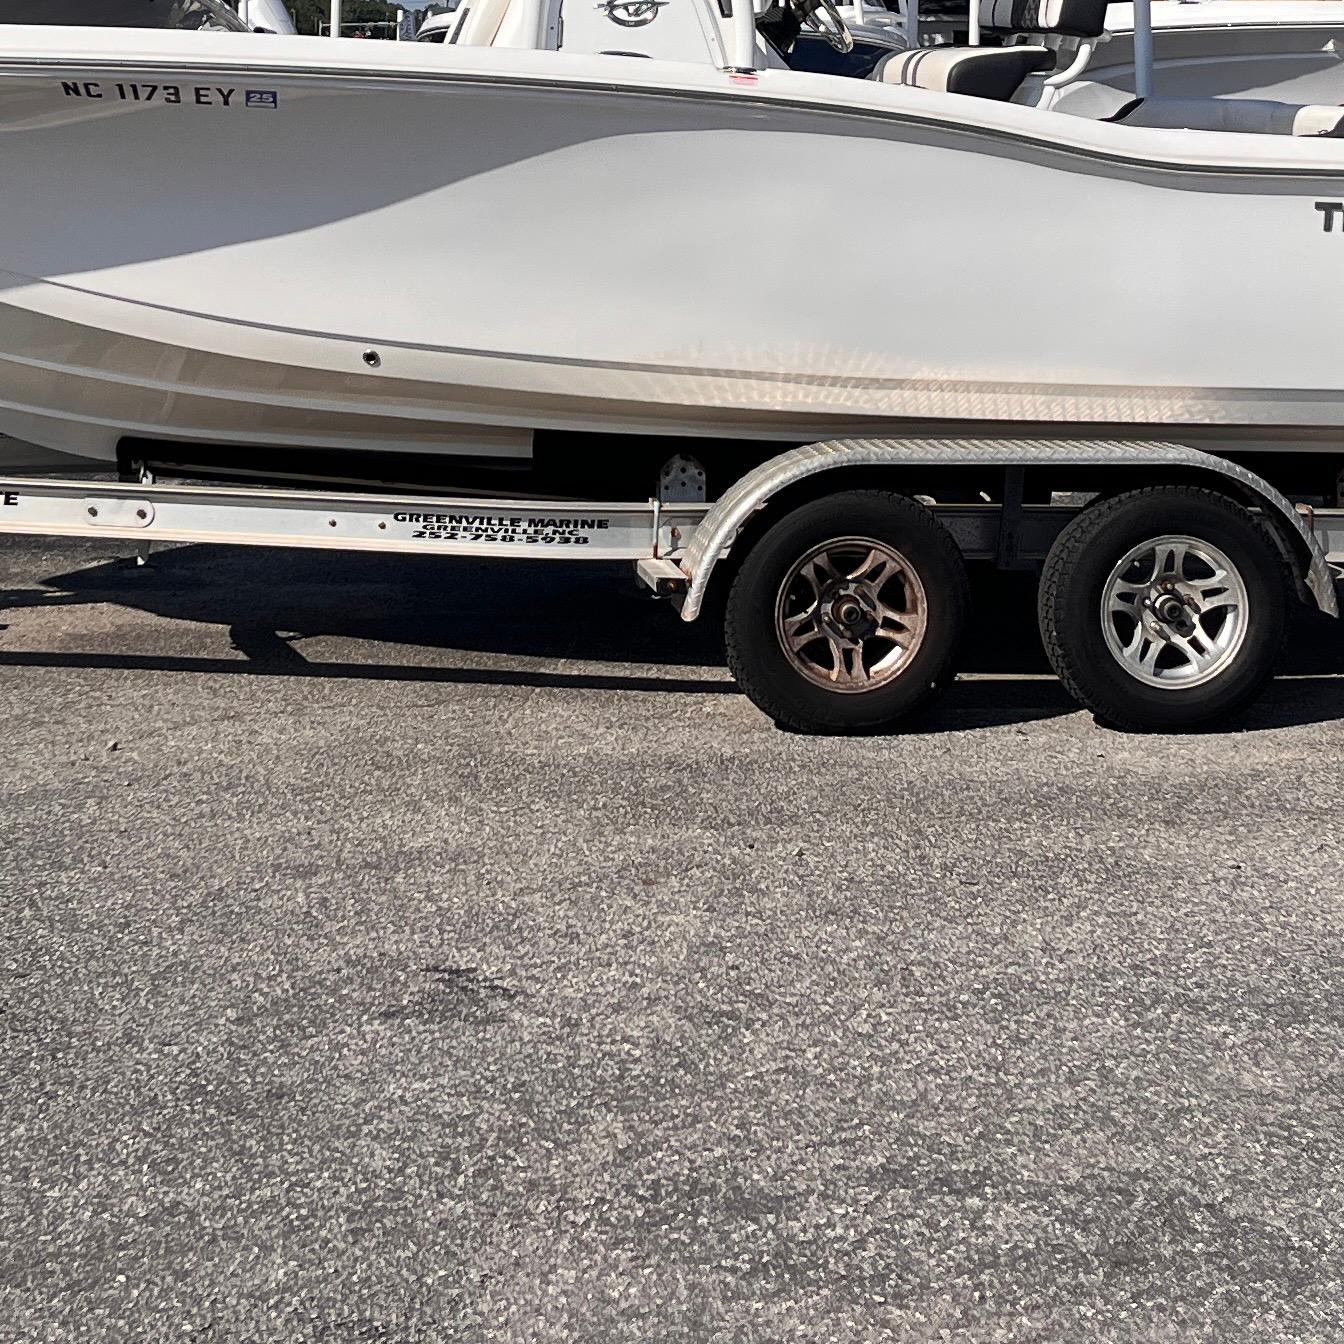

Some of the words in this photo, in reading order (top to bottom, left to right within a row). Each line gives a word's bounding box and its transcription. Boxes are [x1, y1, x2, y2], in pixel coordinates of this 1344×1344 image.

[61, 81, 103, 99] NC
[114, 83, 182, 104] 1173
[193, 87, 236, 106] EY
[249, 93, 274, 102] 25
[393, 512, 522, 528] GREENVILLE
[527, 518, 610, 529] MARINE
